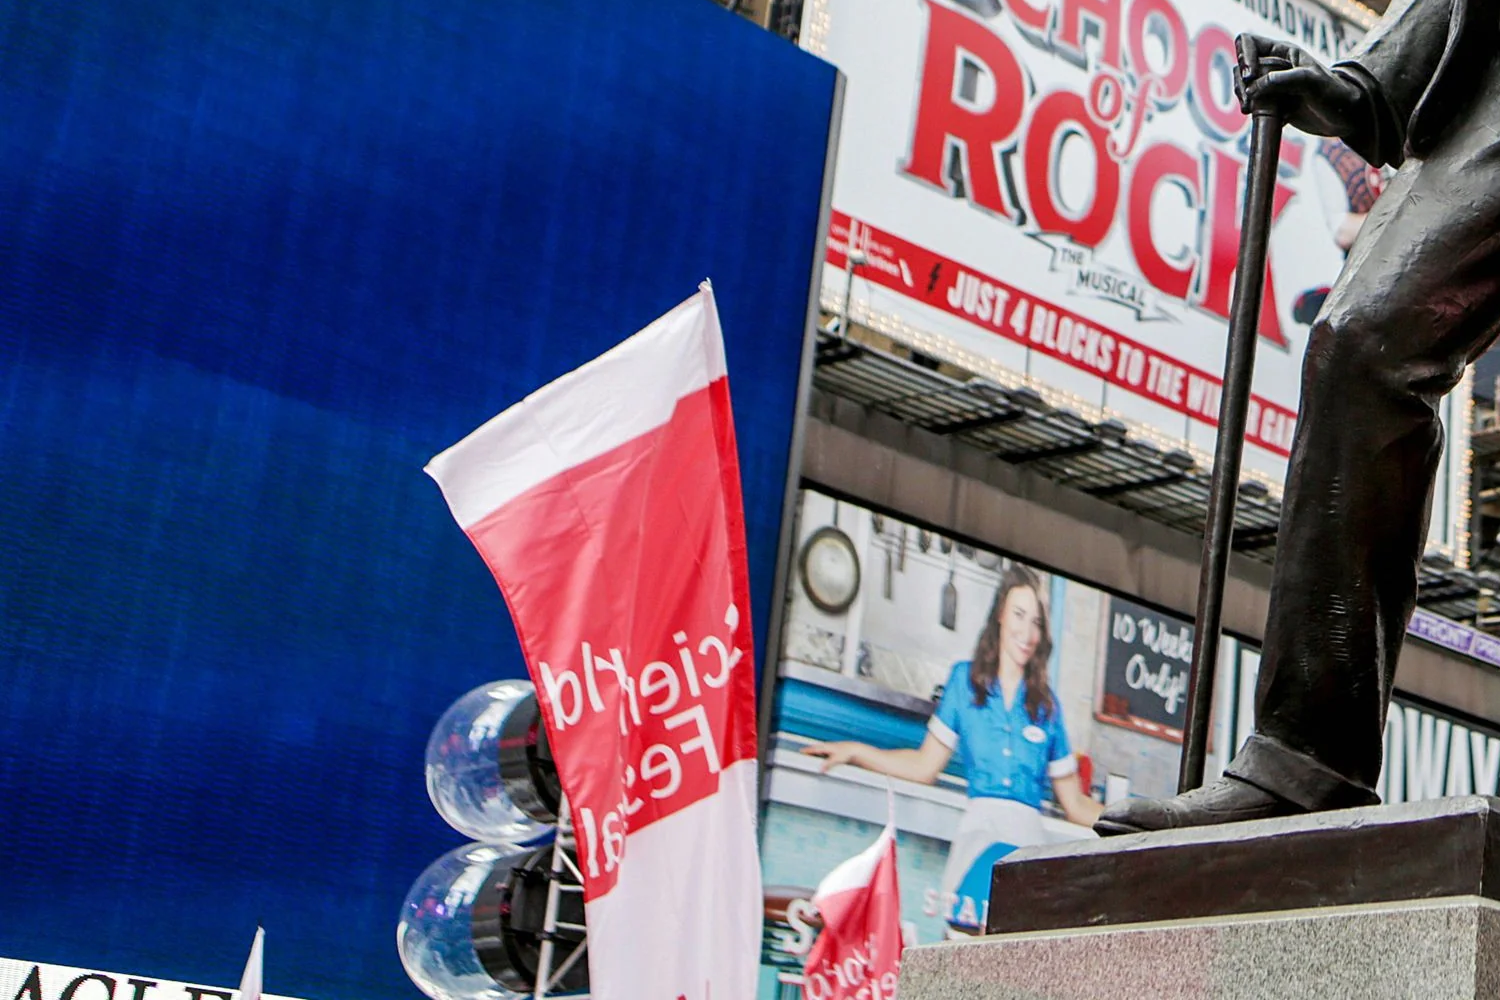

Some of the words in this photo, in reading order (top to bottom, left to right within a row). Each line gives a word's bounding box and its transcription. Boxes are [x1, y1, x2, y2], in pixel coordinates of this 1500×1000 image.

[1084, 69, 1168, 164] of
[1060, 247, 1085, 266] THE
[1077, 269, 1147, 307] MUSICAL
[947, 270, 1010, 327] JUST
[1009, 298, 1029, 338] 4
[1029, 304, 1116, 374] BLOCKS
[1115, 341, 1147, 387] TO
[1147, 356, 1187, 405] THE
[1113, 612, 1136, 643] 10
